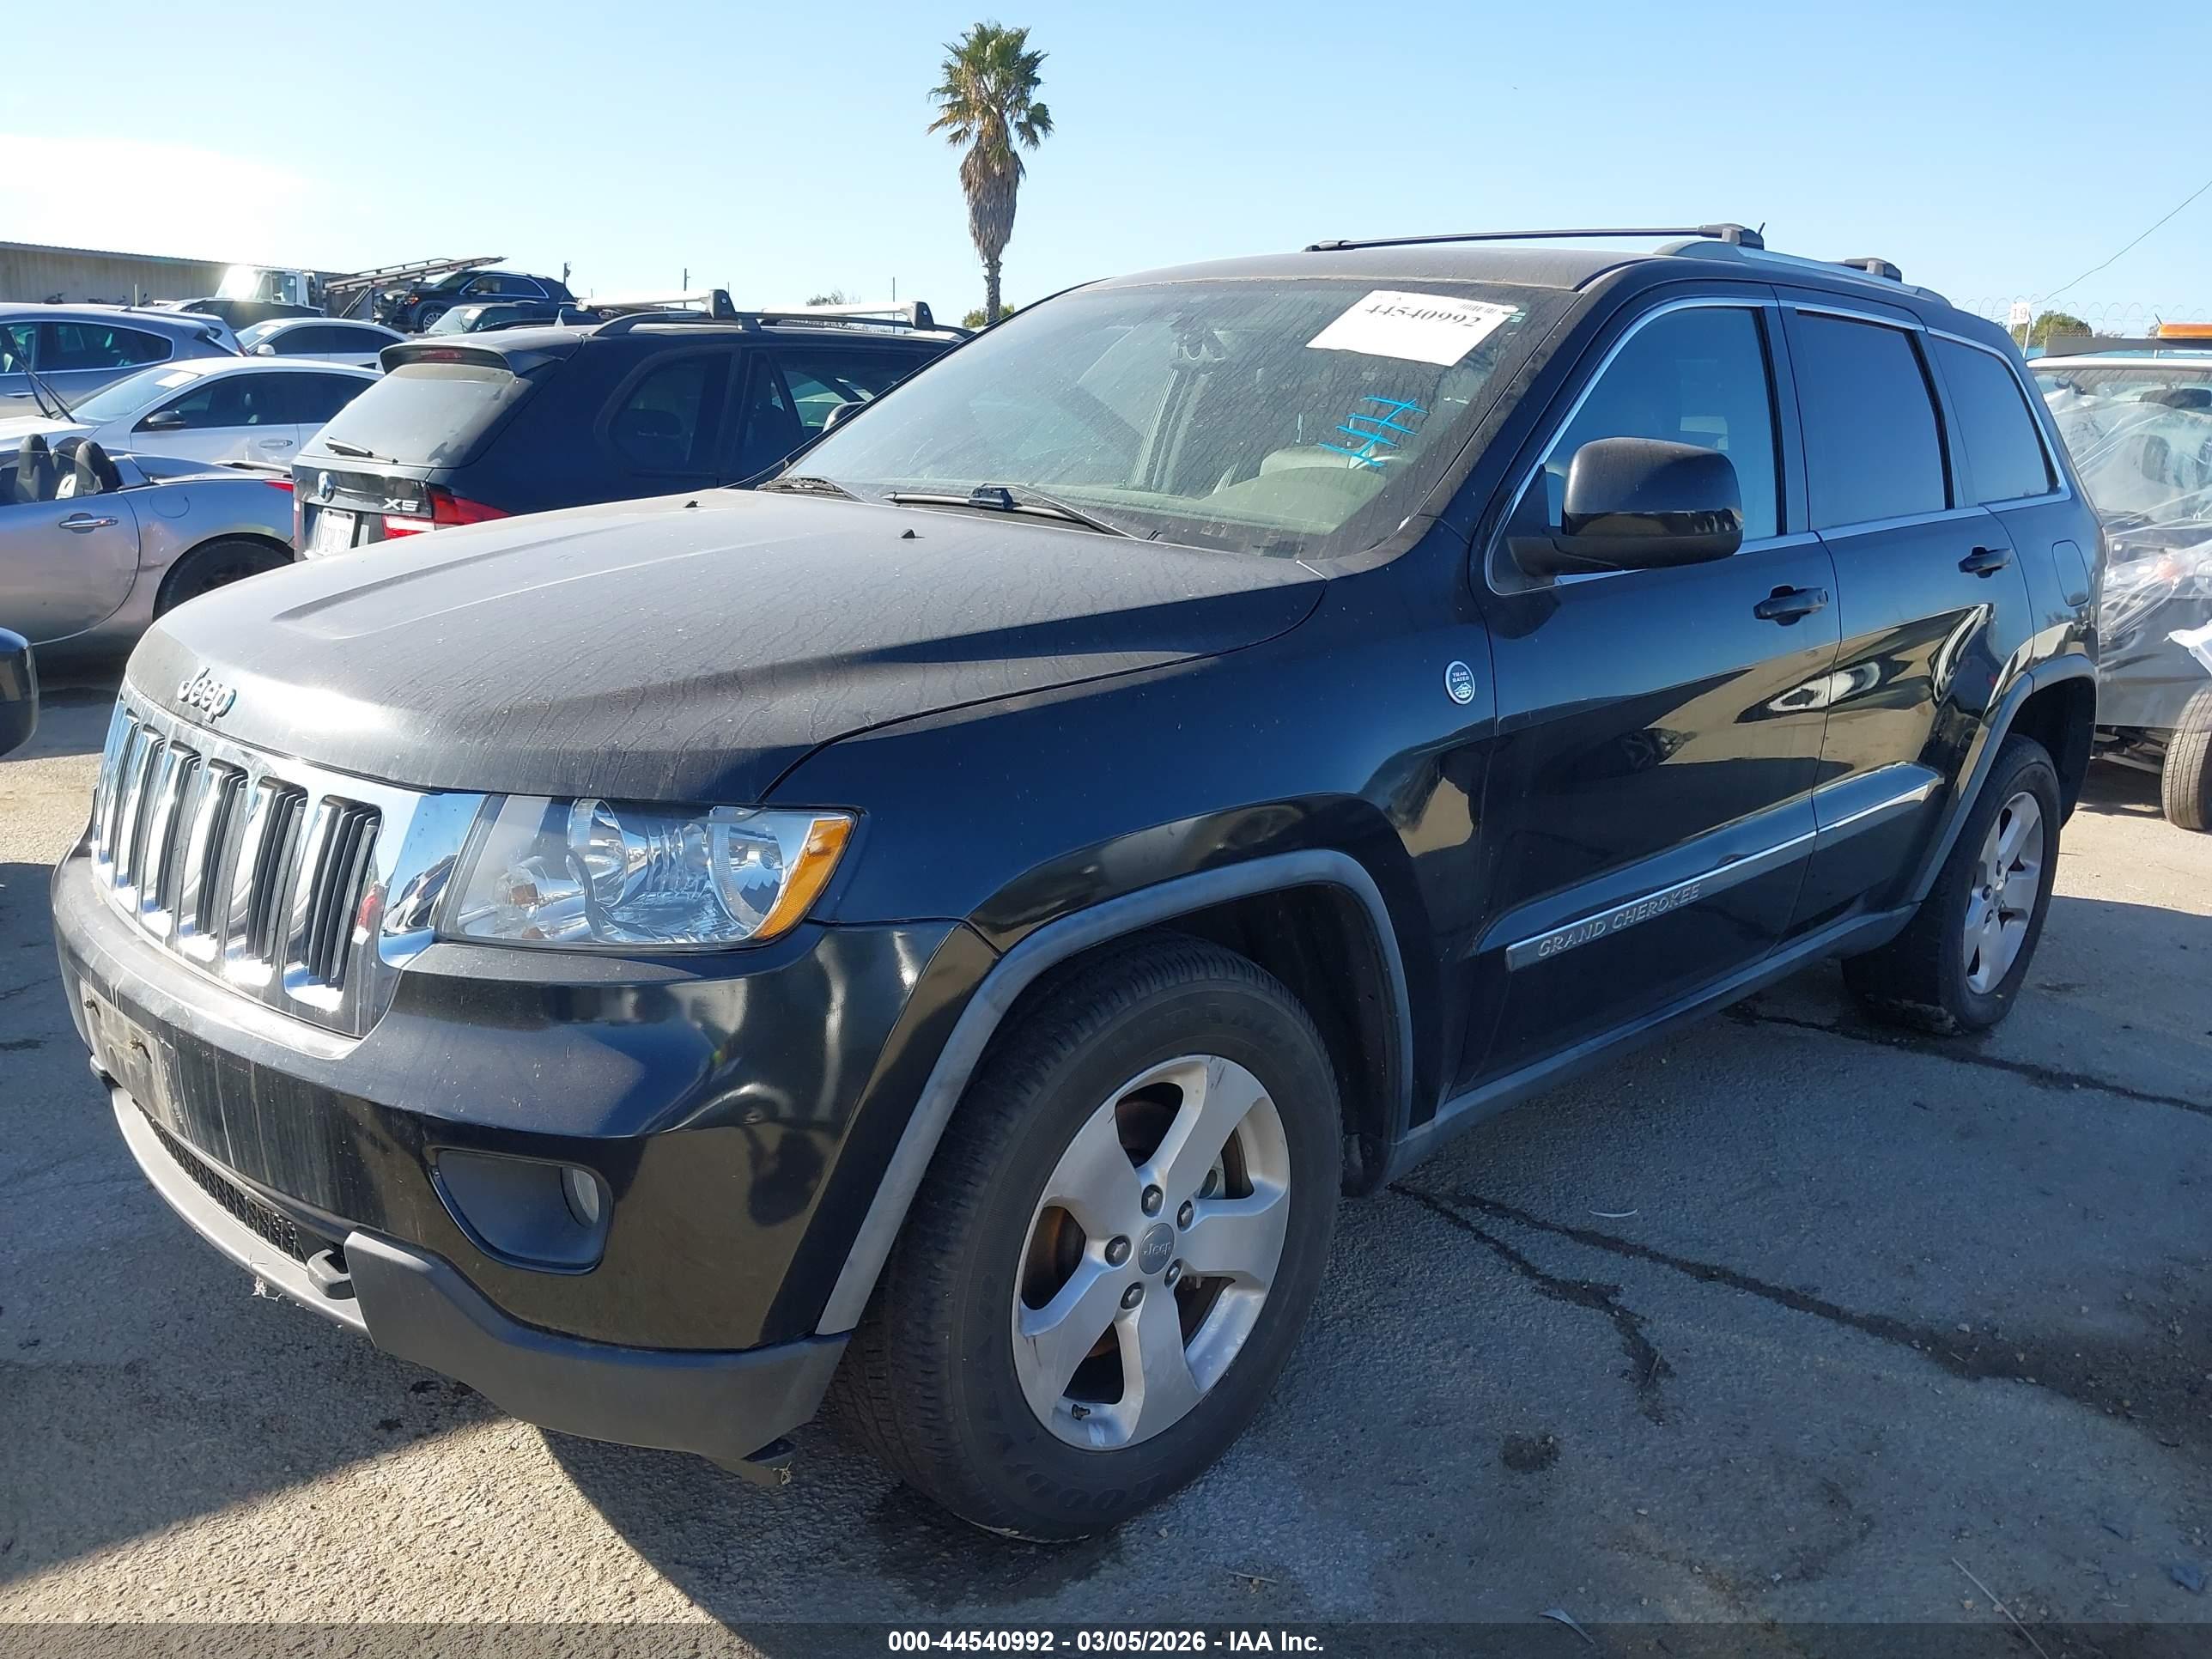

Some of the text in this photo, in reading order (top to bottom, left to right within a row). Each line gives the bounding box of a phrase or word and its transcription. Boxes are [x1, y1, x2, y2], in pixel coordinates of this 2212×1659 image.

[1365, 304, 1482, 327] 44540992
[2013, 307, 2027, 319] 19
[382, 497, 420, 512] X5
[177, 666, 237, 725] Jeep
[1537, 883, 1702, 957] GRAND CHEROKEE
[1144, 1242, 1172, 1256] Jeep
